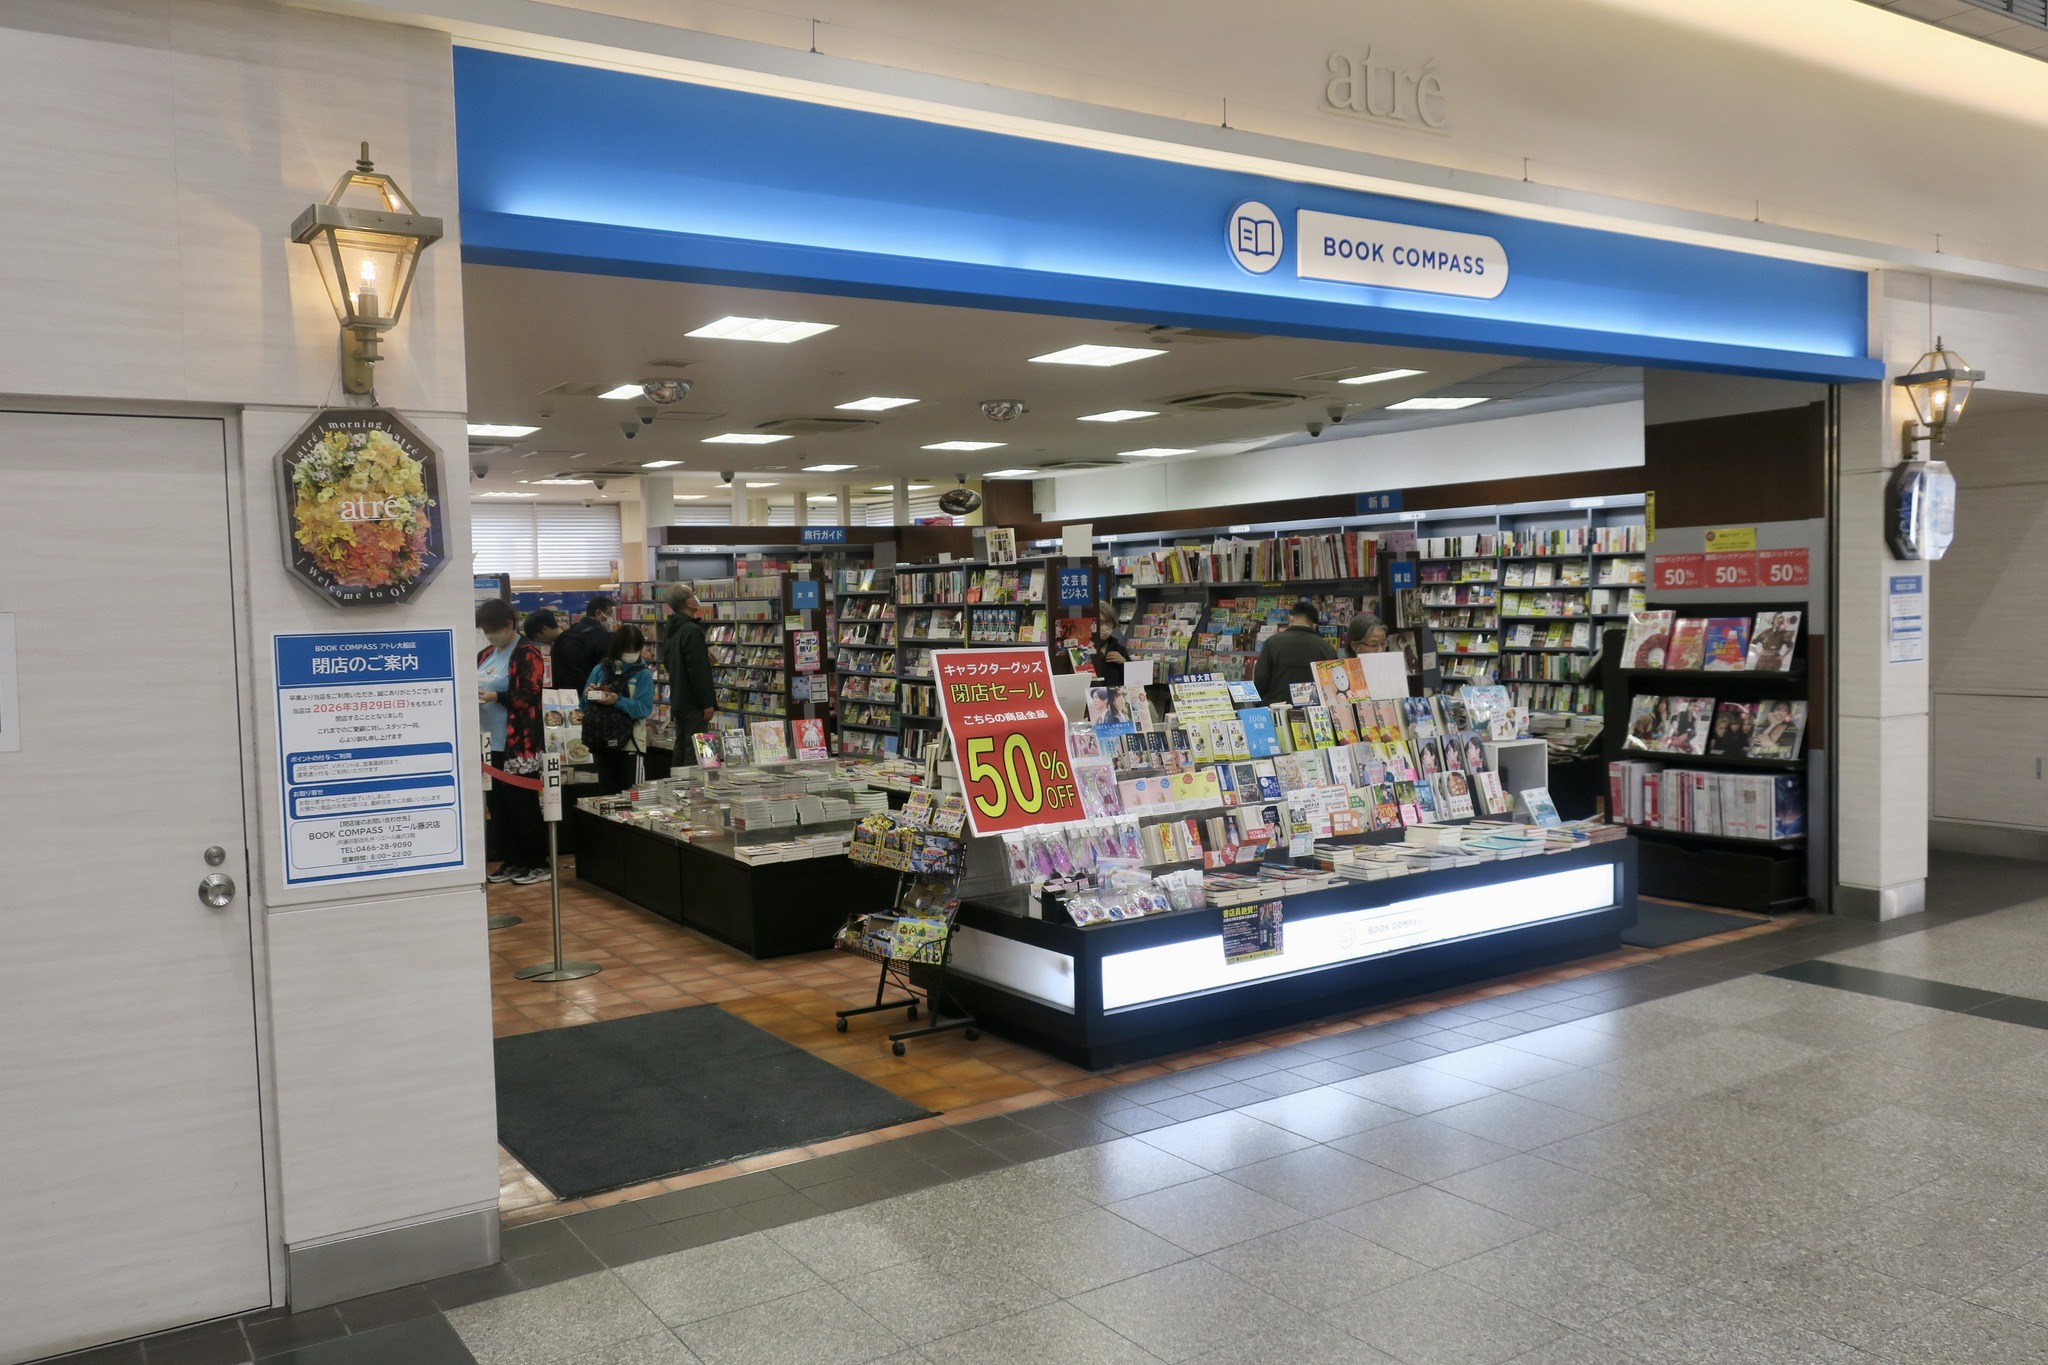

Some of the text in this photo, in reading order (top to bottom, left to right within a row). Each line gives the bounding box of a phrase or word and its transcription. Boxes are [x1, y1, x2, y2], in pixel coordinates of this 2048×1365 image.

[1325, 44, 1446, 128] atré
[1323, 236, 1485, 277] BOOK COMPASS
[327, 419, 383, 430] morning
[339, 494, 401, 521] atré
[1368, 495, 1391, 509] 新書
[804, 529, 843, 541] 旅行ガイド
[1061, 574, 1089, 587] 文芸書
[1394, 572, 1412, 584] 雑誌
[1664, 568, 1695, 586] 50%
[1715, 566, 1748, 584] 50%
[1770, 564, 1804, 582] 50%
[308, 565, 362, 601] Welcome
[369, 590, 384, 600] to
[1061, 588, 1089, 600] ビジネス
[314, 641, 417, 652] BOOK COMPASS アトレ大船店
[795, 638, 818, 647] クーポン
[311, 654, 419, 675] 閉店のご案内
[944, 661, 1043, 677] キャラクターグッズ
[950, 681, 1045, 704] 閉店セール
[963, 710, 1049, 726] こちらの商品全品
[547, 758, 560, 788] 出口
[1046, 784, 1076, 810] OFF
[308, 821, 441, 841] BOOK COMPASS リエール藤沢店
[340, 841, 413, 854] TEL:0466-28-9090
[1368, 917, 1426, 935] BOOK COMPA
